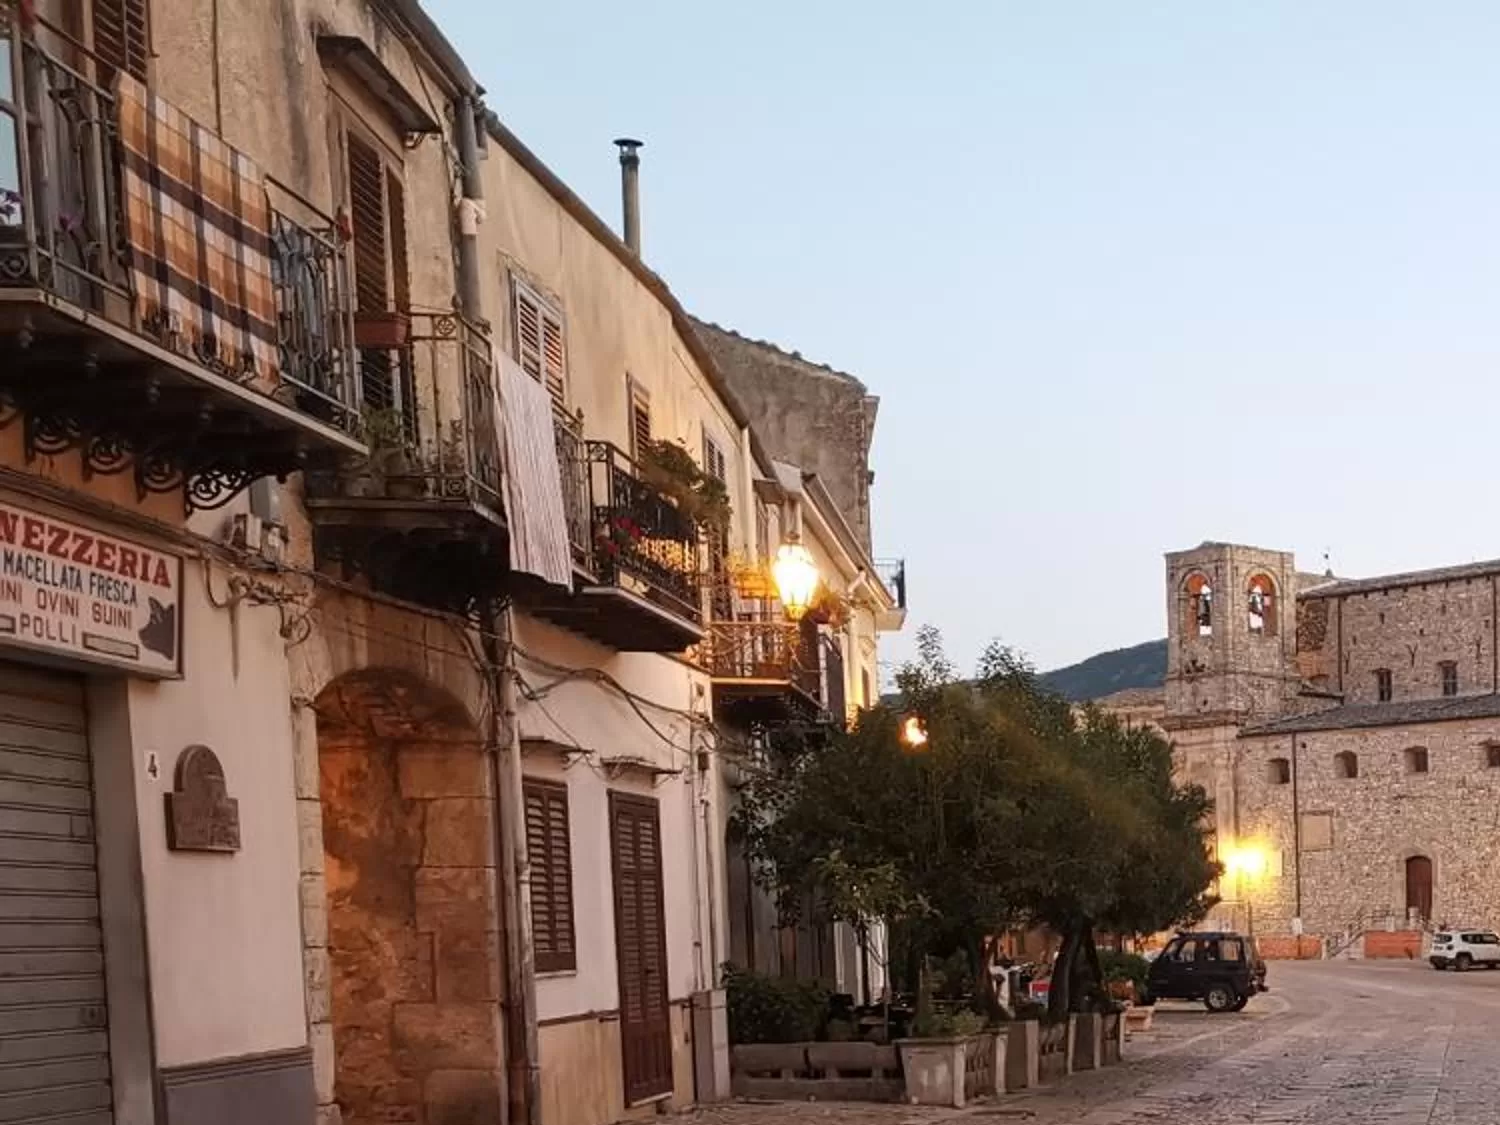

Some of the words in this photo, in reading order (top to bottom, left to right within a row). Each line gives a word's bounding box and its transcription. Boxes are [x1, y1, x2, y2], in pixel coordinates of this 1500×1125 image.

[3, 547, 83, 593] MACELLATA
[90, 571, 138, 608] FRESCA
[20, 612, 76, 645] POLLI
[37, 588, 79, 617] OVINI
[92, 602, 132, 630] SUINI
